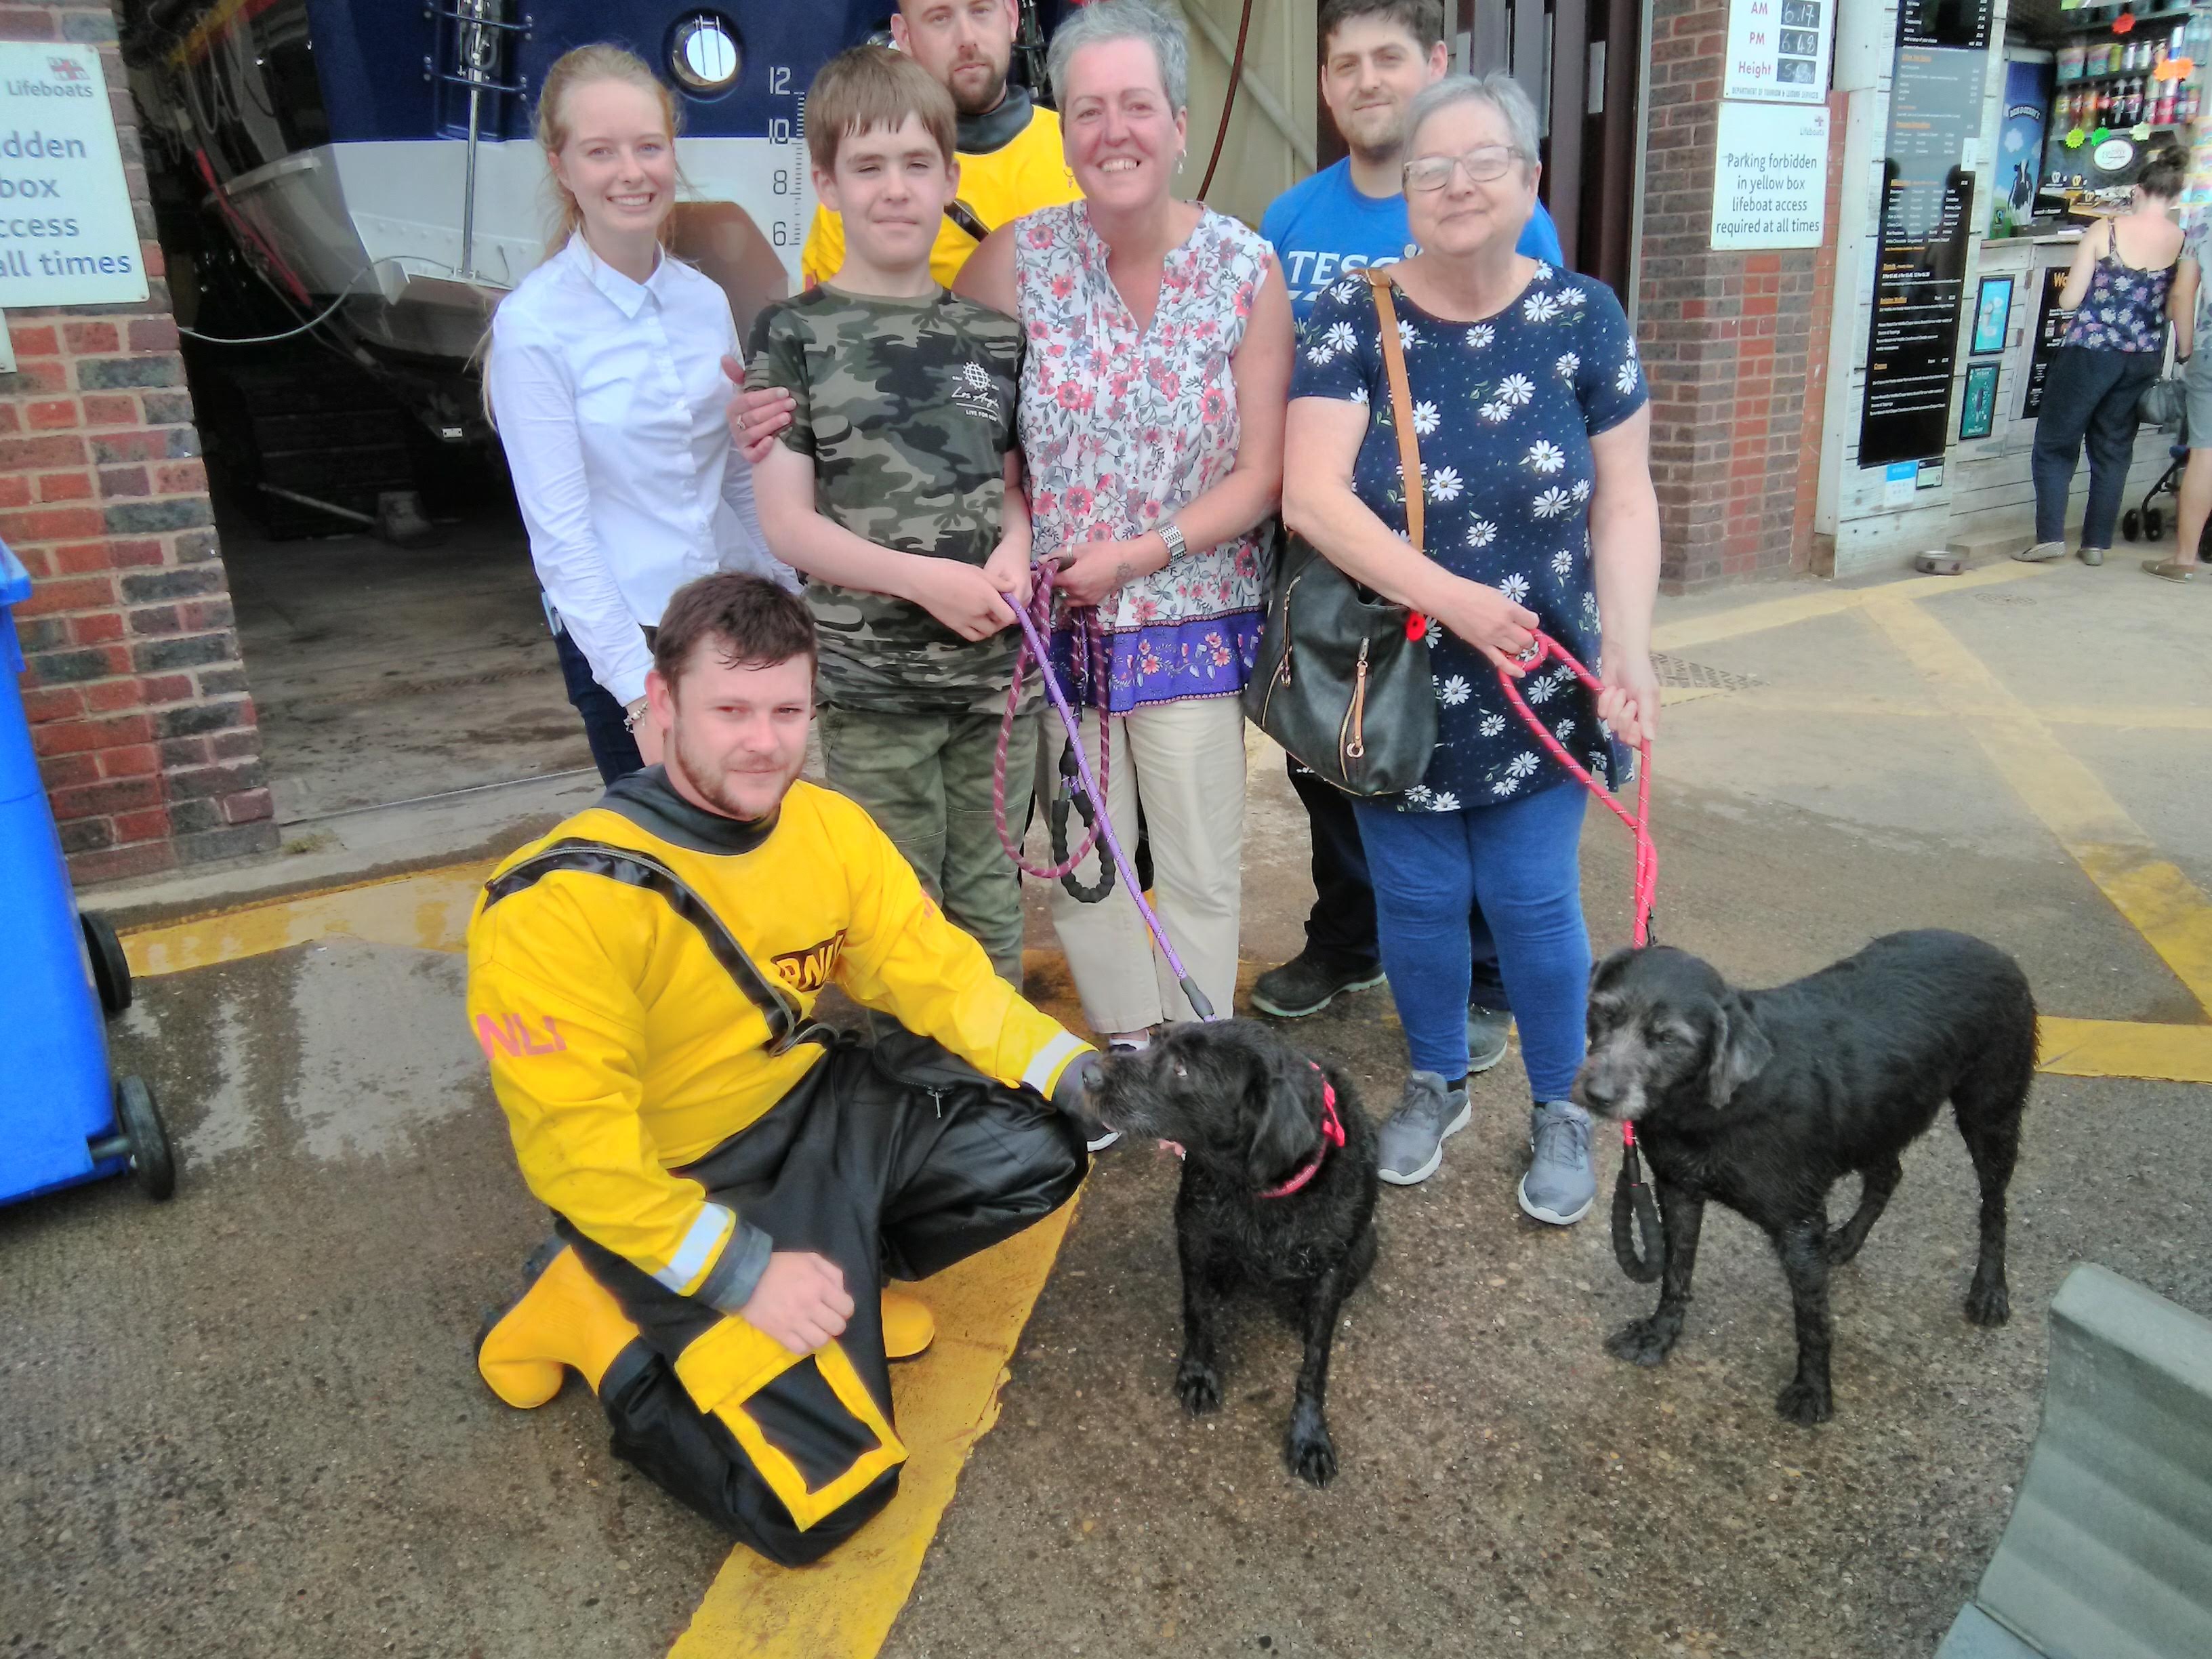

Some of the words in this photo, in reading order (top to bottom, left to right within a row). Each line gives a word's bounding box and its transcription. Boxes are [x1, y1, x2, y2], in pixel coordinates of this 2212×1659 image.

[1751, 2, 1767, 15] AM
[1749, 32, 1765, 45] PM
[1738, 61, 1771, 78] Height
[7, 79, 93, 98] Lifeboats
[769, 66, 792, 95] 12
[769, 119, 790, 144] 10
[1800, 127, 1824, 136] Lifeboats
[1727, 152, 1765, 172] Parking
[1769, 153, 1817, 169] forbidden
[773, 169, 787, 194] 8
[1738, 175, 1747, 190] in
[1749, 175, 1784, 194] yellow
[1787, 176, 1805, 190] box
[1732, 197, 1772, 211] lifeboat
[1776, 200, 1807, 211] access
[773, 222, 786, 246] 6
[1717, 218, 1761, 237] required
[1763, 220, 1774, 232] at
[1777, 218, 1788, 232] all
[1792, 218, 1820, 232] times
[39, 249, 132, 276] times
[951, 386, 971, 398] Los
